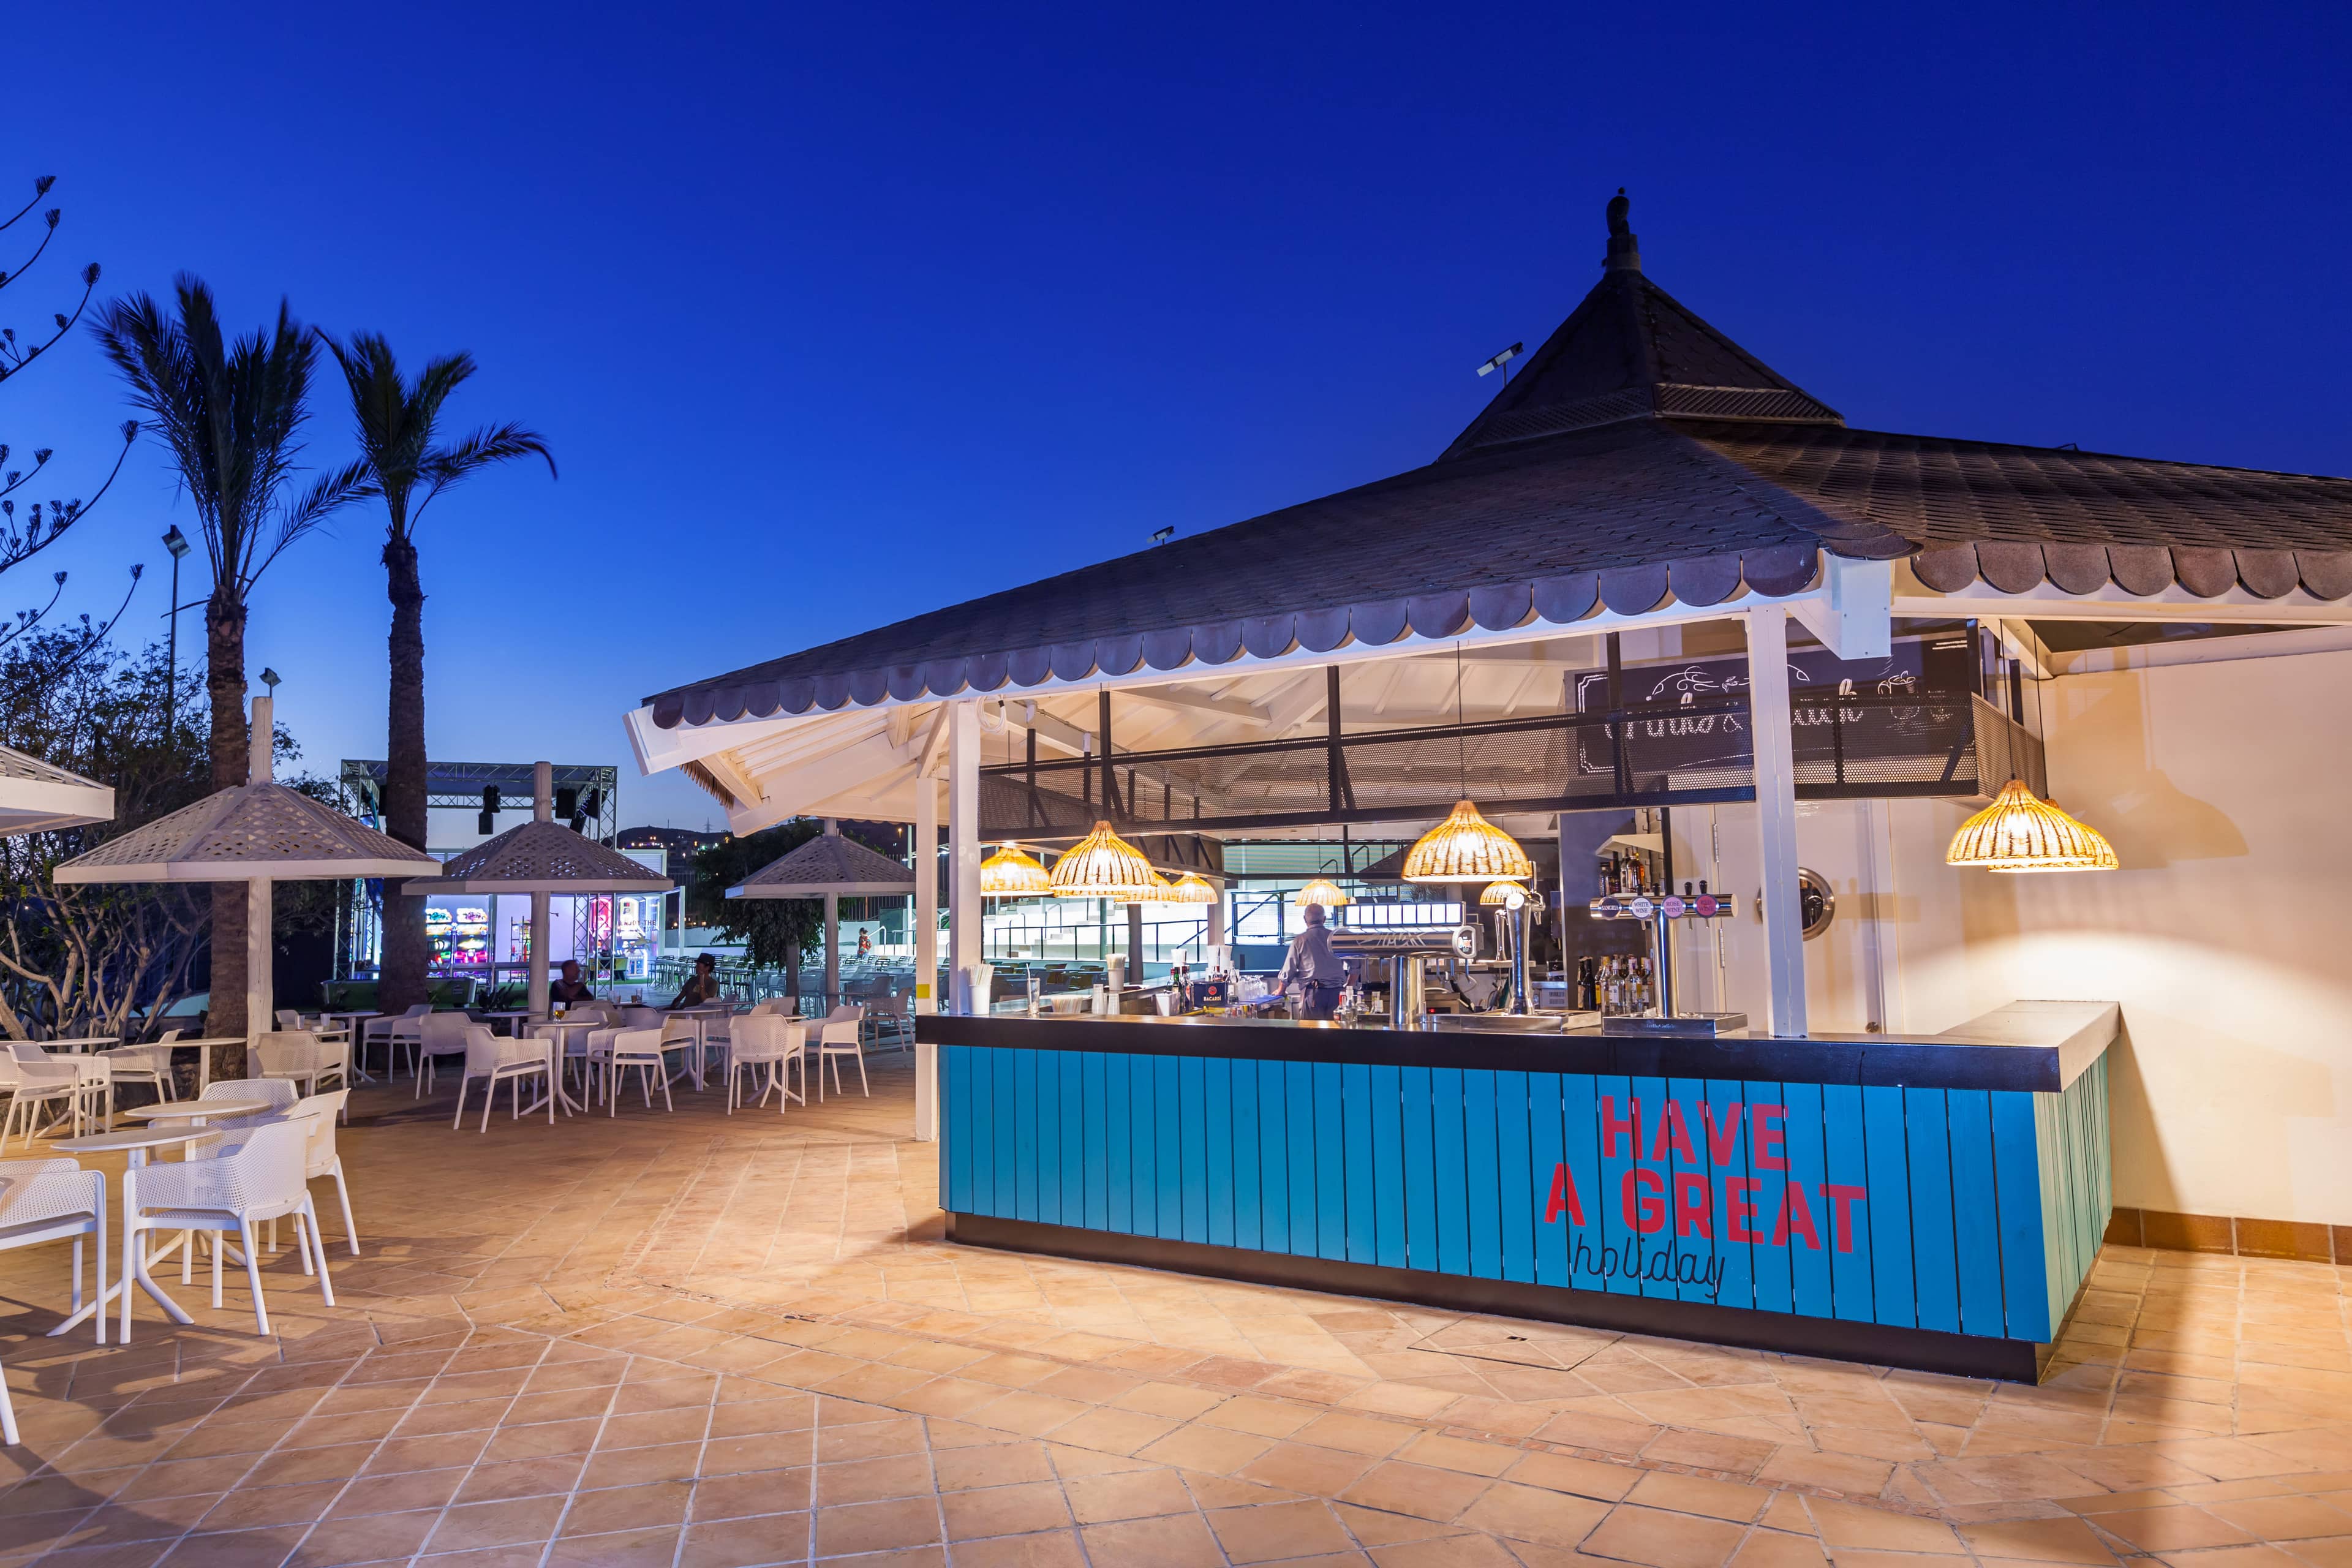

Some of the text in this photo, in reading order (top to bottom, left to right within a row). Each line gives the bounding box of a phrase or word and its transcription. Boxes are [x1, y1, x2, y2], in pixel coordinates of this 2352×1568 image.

[1601, 1095, 1792, 1172] HAVE
[1544, 1162, 1866, 1254] A GREAT
[1573, 1232, 1726, 1299] holiday
